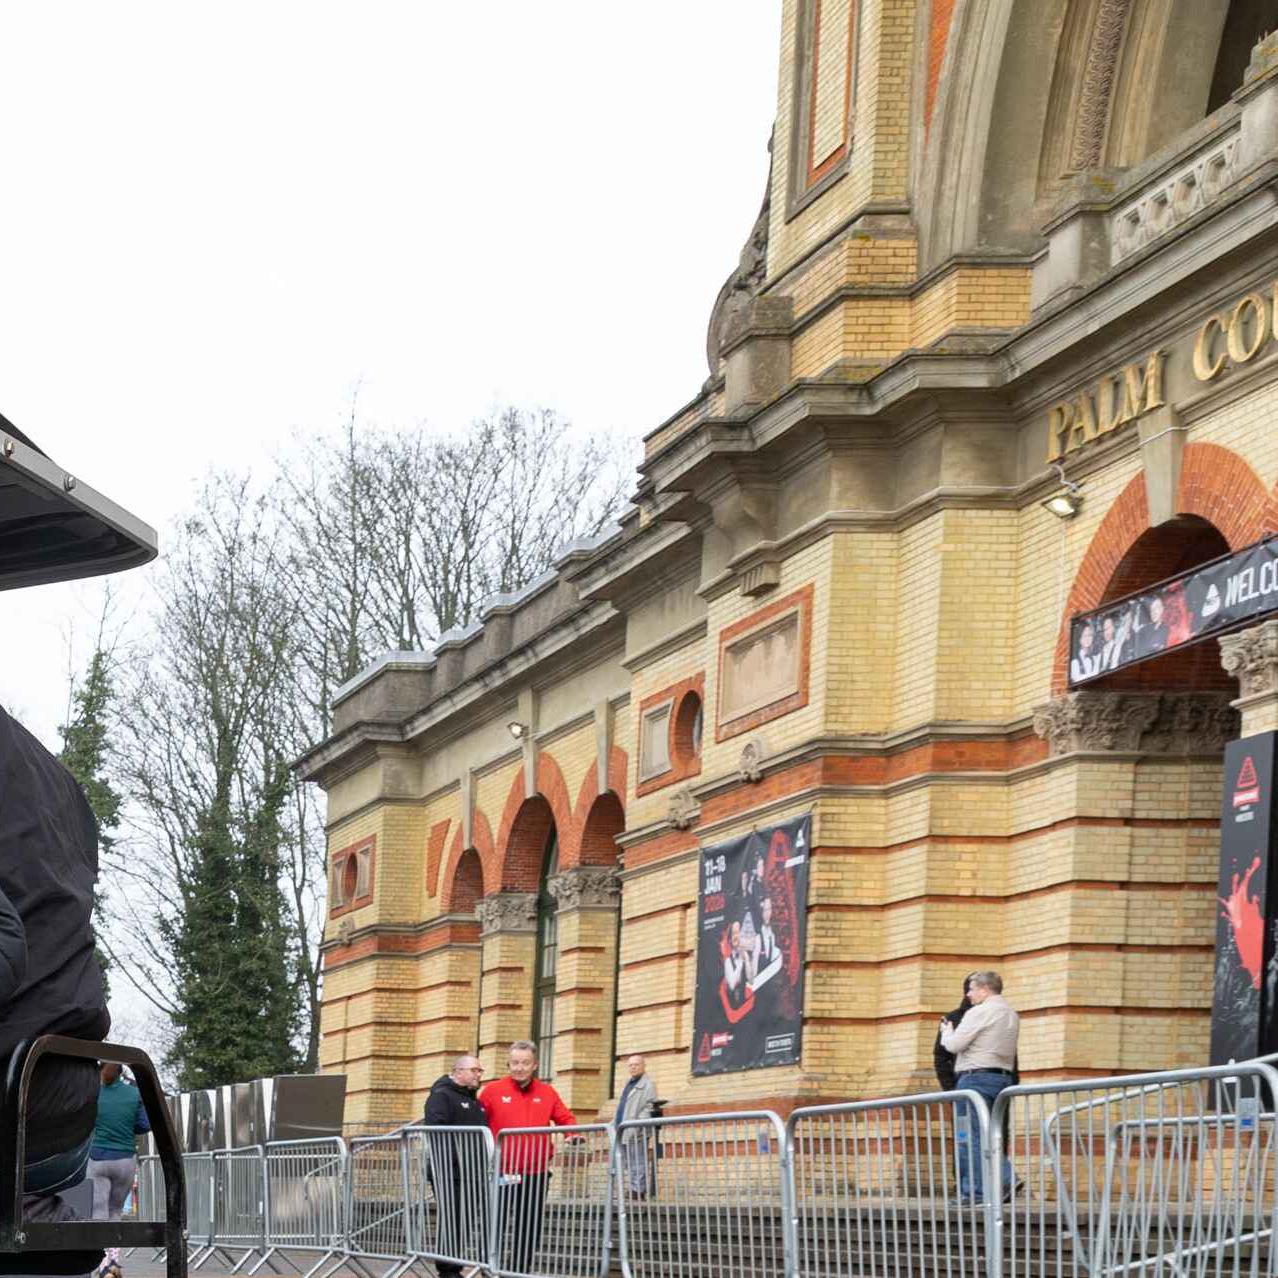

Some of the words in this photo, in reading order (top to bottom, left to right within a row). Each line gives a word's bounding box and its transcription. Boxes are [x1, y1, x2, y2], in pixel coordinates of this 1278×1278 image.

[1045, 350, 1166, 464] PALM
[1193, 278, 1278, 381] CO
[704, 875, 722, 895] JAN
